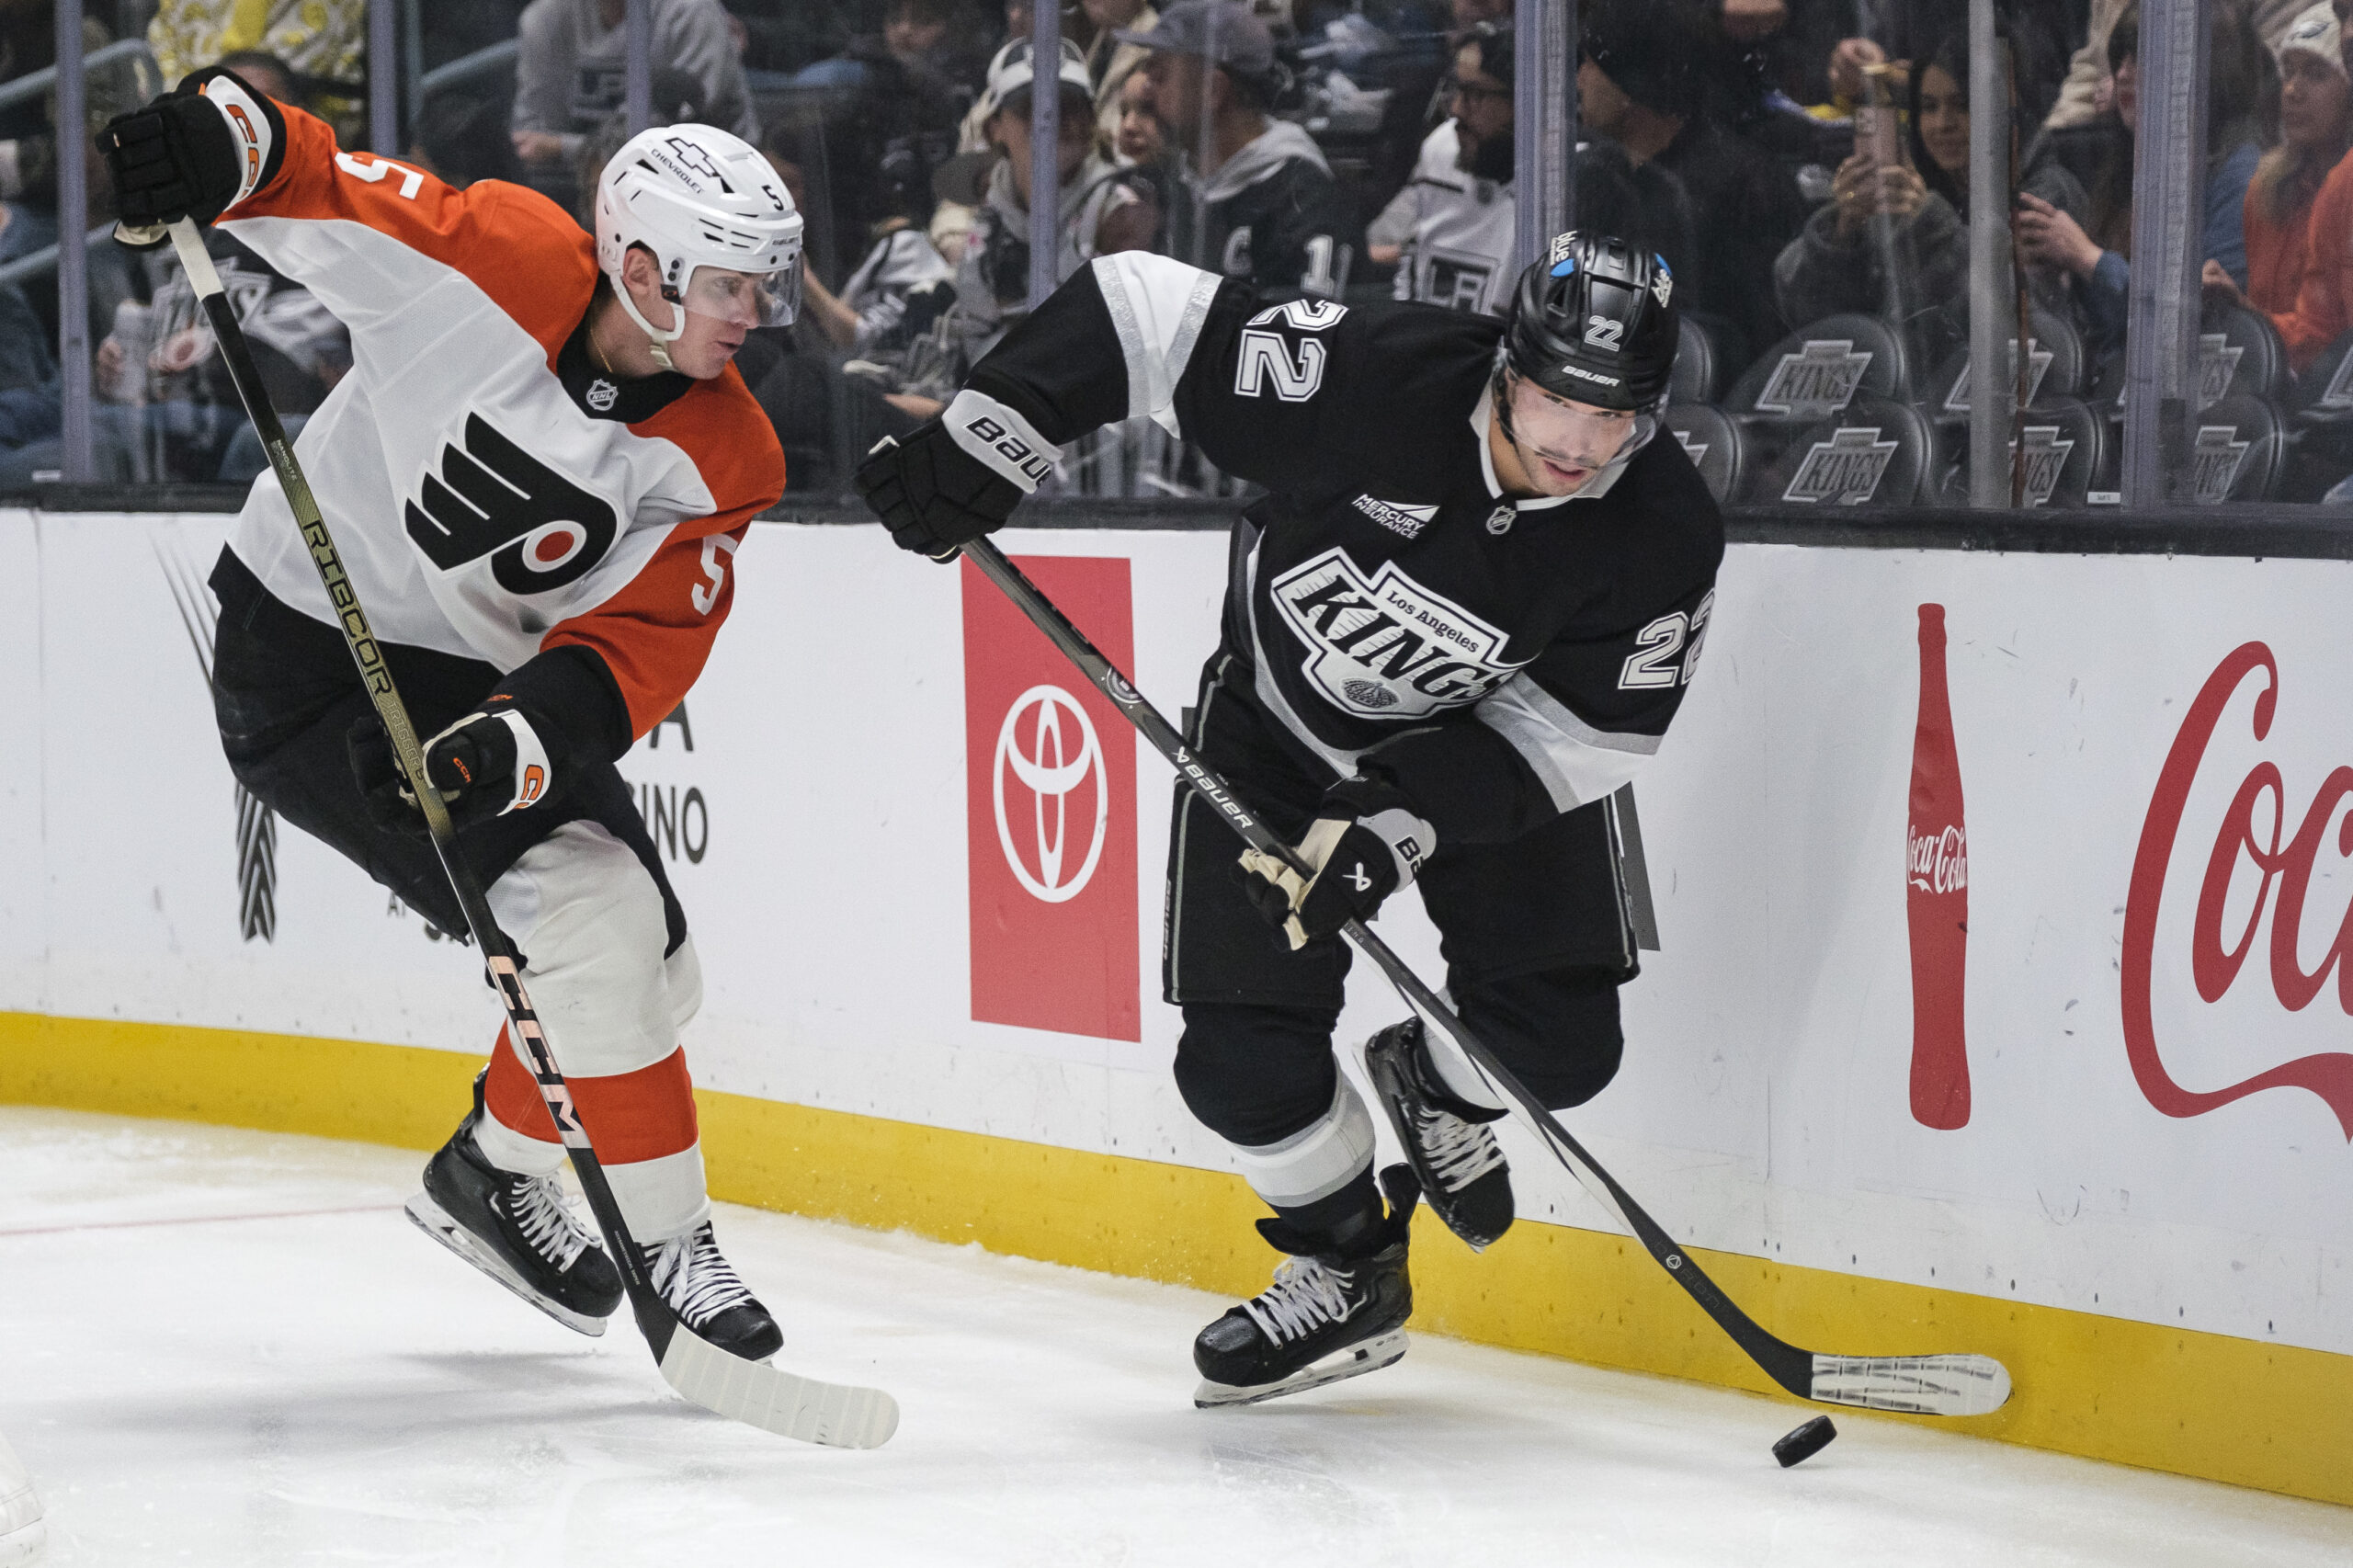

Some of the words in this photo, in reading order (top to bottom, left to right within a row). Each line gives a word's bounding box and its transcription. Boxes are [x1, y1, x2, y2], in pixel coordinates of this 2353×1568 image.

[335, 151, 425, 200] 5
[651, 148, 706, 194] CHEVROLET
[761, 184, 784, 211] 5
[1234, 299, 1350, 403] 22
[1584, 314, 1624, 353] 22
[1562, 365, 1621, 388] BAUER
[1798, 452, 1885, 492] KINGS
[1351, 499, 1420, 540] INSURANCE
[1358, 493, 1426, 531] MERCURY
[690, 532, 739, 617] 5
[302, 518, 393, 697] RIBCOR
[1386, 590, 1415, 616] Los
[1414, 608, 1480, 653] Angeles
[387, 700, 423, 770] TRIGGER
[452, 757, 472, 783] CCM
[1185, 764, 1254, 829] BAUER
[1907, 824, 1968, 894] Coca-Cola
[488, 955, 594, 1150] CCM
